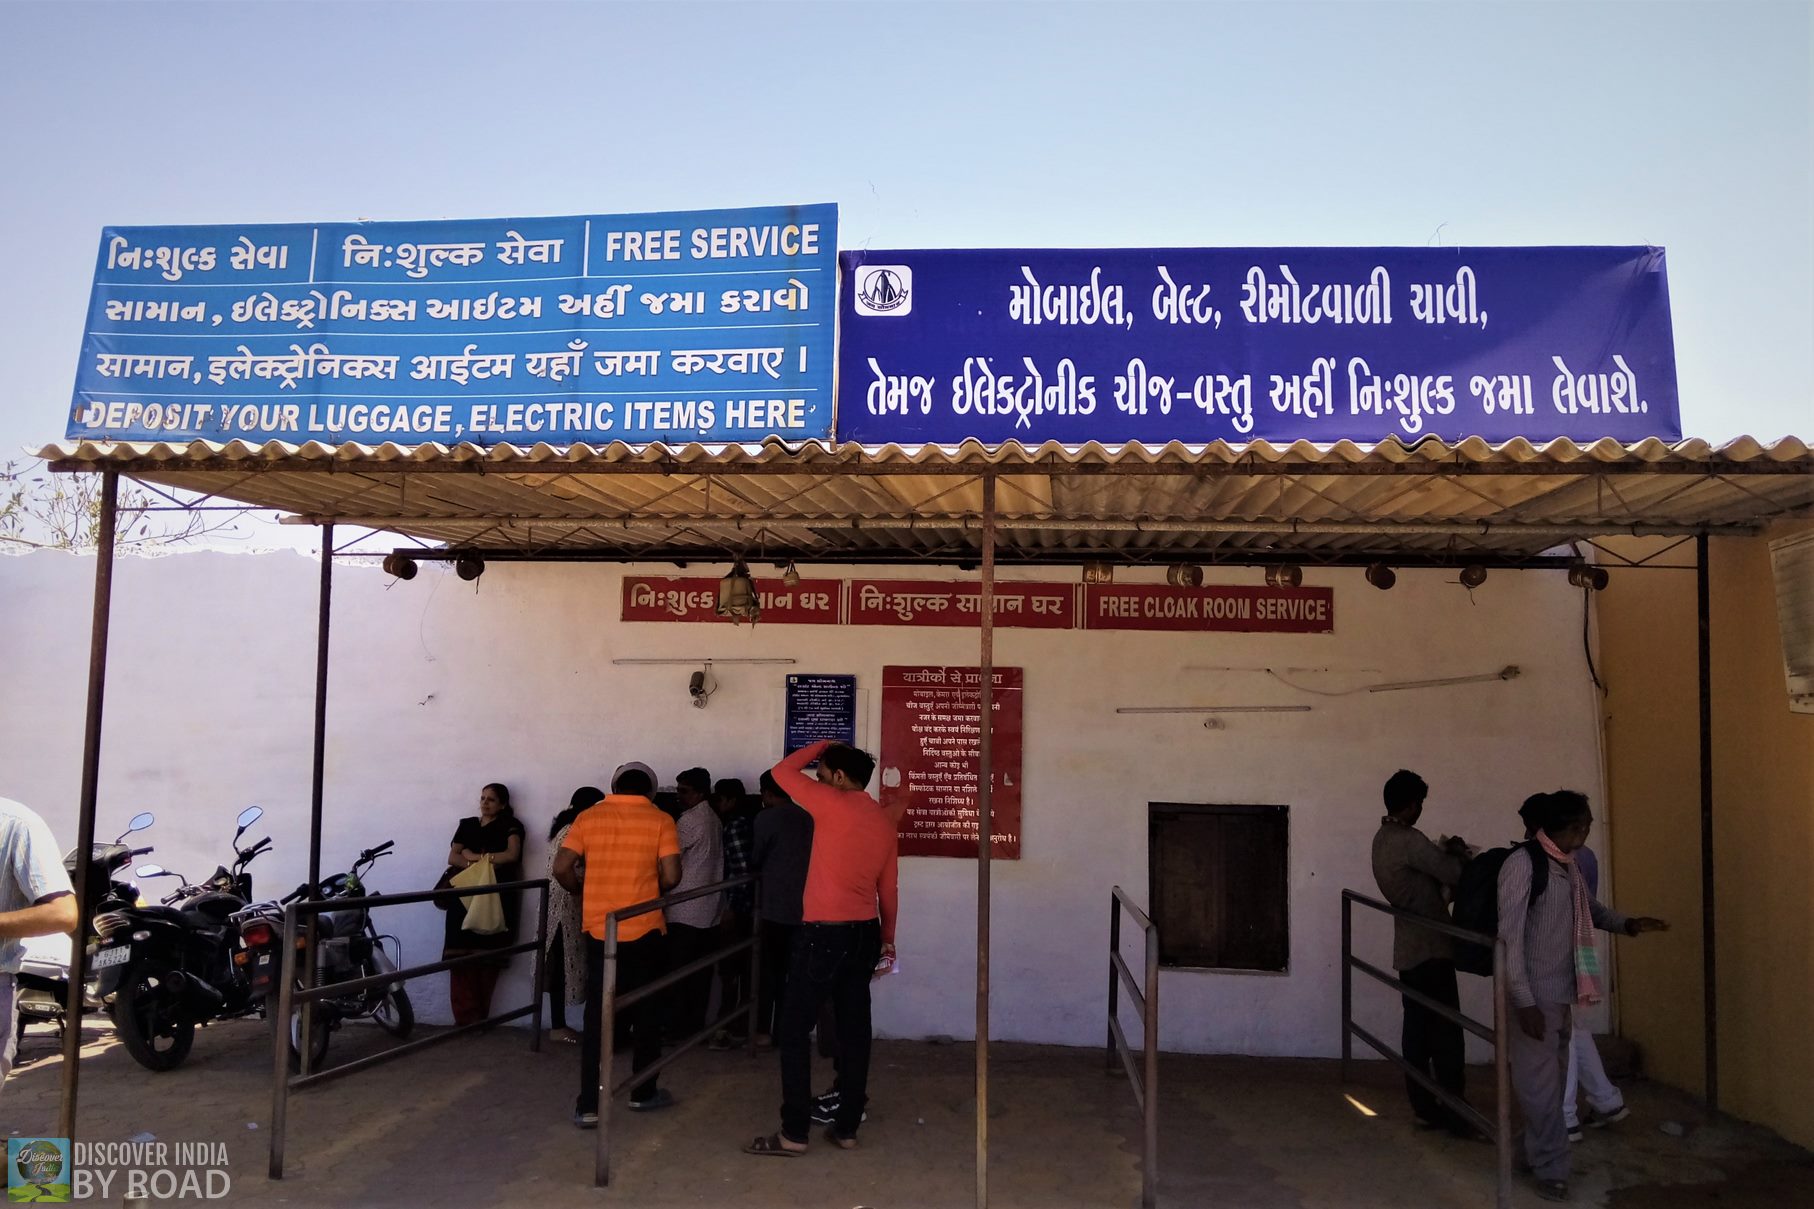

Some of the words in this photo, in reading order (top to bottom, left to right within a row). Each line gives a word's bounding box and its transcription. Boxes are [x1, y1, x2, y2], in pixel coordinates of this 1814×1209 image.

[107, 237, 216, 281] નિઃશુલ્ક
[230, 236, 288, 271] સેવા
[497, 231, 564, 265] सेवा
[606, 230, 681, 261] FREE
[690, 224, 819, 258] SERVICE
[558, 284, 633, 318] અહીં
[640, 292, 704, 315] જમા
[720, 279, 808, 314] કરાવો
[1152, 266, 1222, 330] બેલ્ટ,
[1239, 265, 1393, 324] રીમોટવાળી
[1410, 265, 1489, 330] ચાવી,
[96, 354, 202, 385] सामान,
[410, 344, 515, 385] आईटम
[526, 338, 588, 381] यहाँ
[594, 351, 661, 377] जमा
[671, 347, 783, 379] करवाए
[866, 357, 936, 416] તેમજ
[1269, 357, 1336, 419] અહીં
[1348, 356, 1456, 432] નિઃશુલ્ક
[1469, 375, 1534, 415] જમા
[1552, 355, 1648, 415] લેવાશે.
[85, 401, 211, 430] DEPOSIT
[220, 404, 300, 431] YOUR
[308, 403, 464, 437] LUGGAGE,
[470, 402, 614, 432] ELECTRIC
[624, 401, 715, 431] ITEMS
[726, 400, 805, 428] HERE
[799, 591, 830, 610] ઘર
[1031, 596, 1064, 615] घर
[1100, 596, 1139, 618] FREE
[1144, 596, 1198, 619] CLOAK
[1203, 597, 1250, 620] ROOM
[1256, 598, 1326, 621] SERVICE
[950, 670, 962, 683] से
